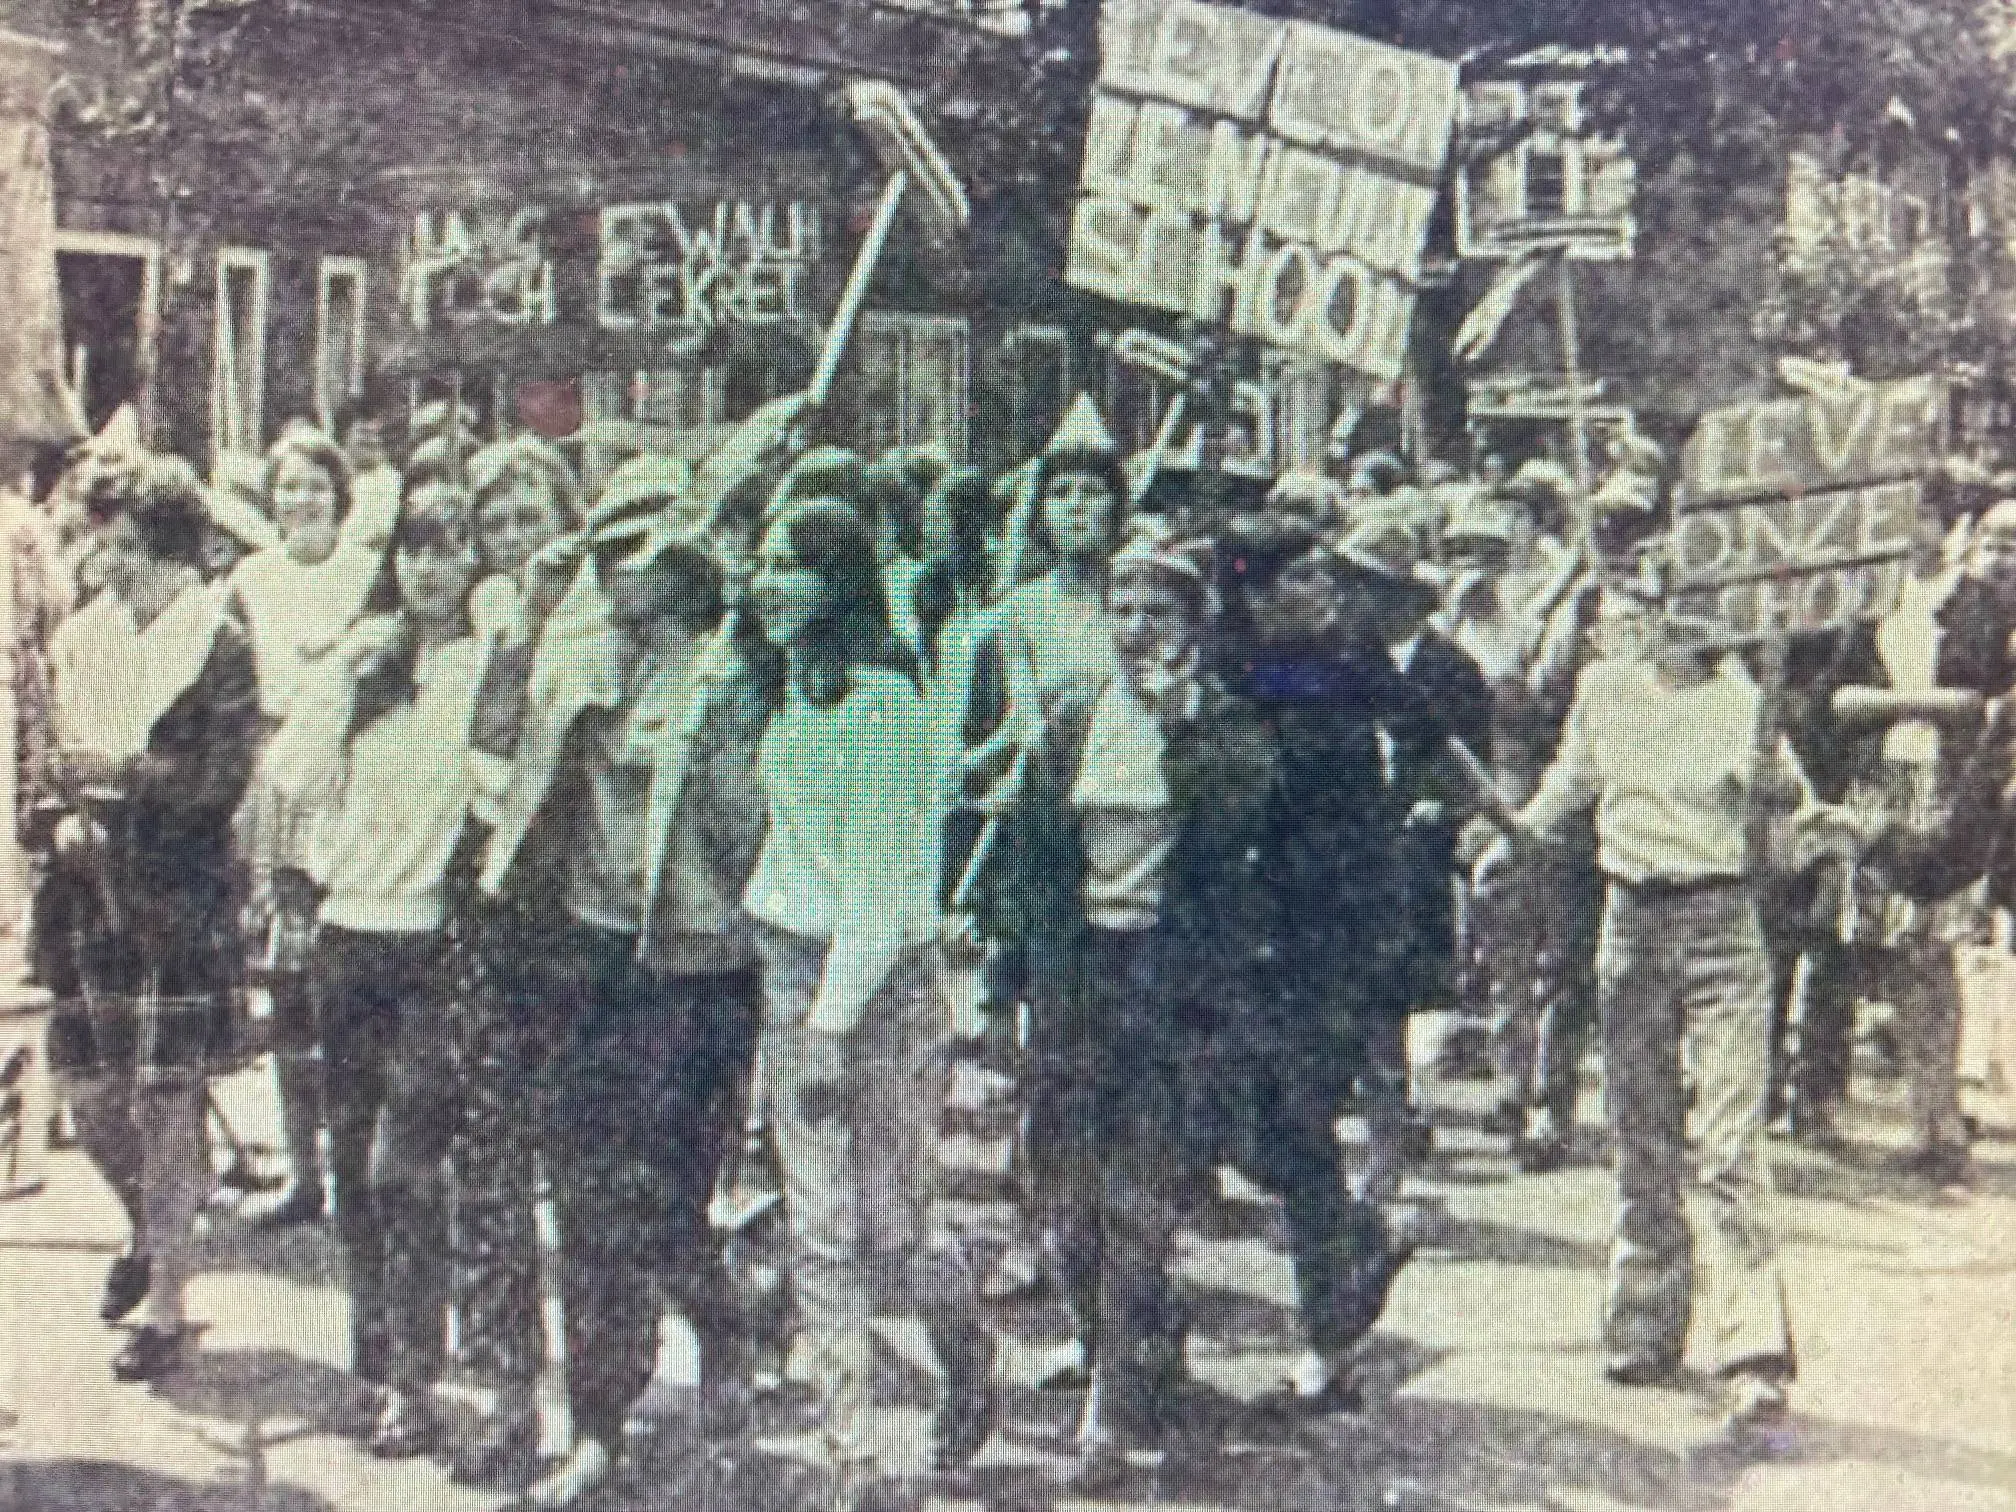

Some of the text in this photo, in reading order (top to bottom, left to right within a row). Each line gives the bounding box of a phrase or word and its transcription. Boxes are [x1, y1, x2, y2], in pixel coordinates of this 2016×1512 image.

[1067, 195, 1412, 380] SCHOOL
[1699, 378, 1938, 492] LEVE
[1674, 482, 1918, 573] ONZE
